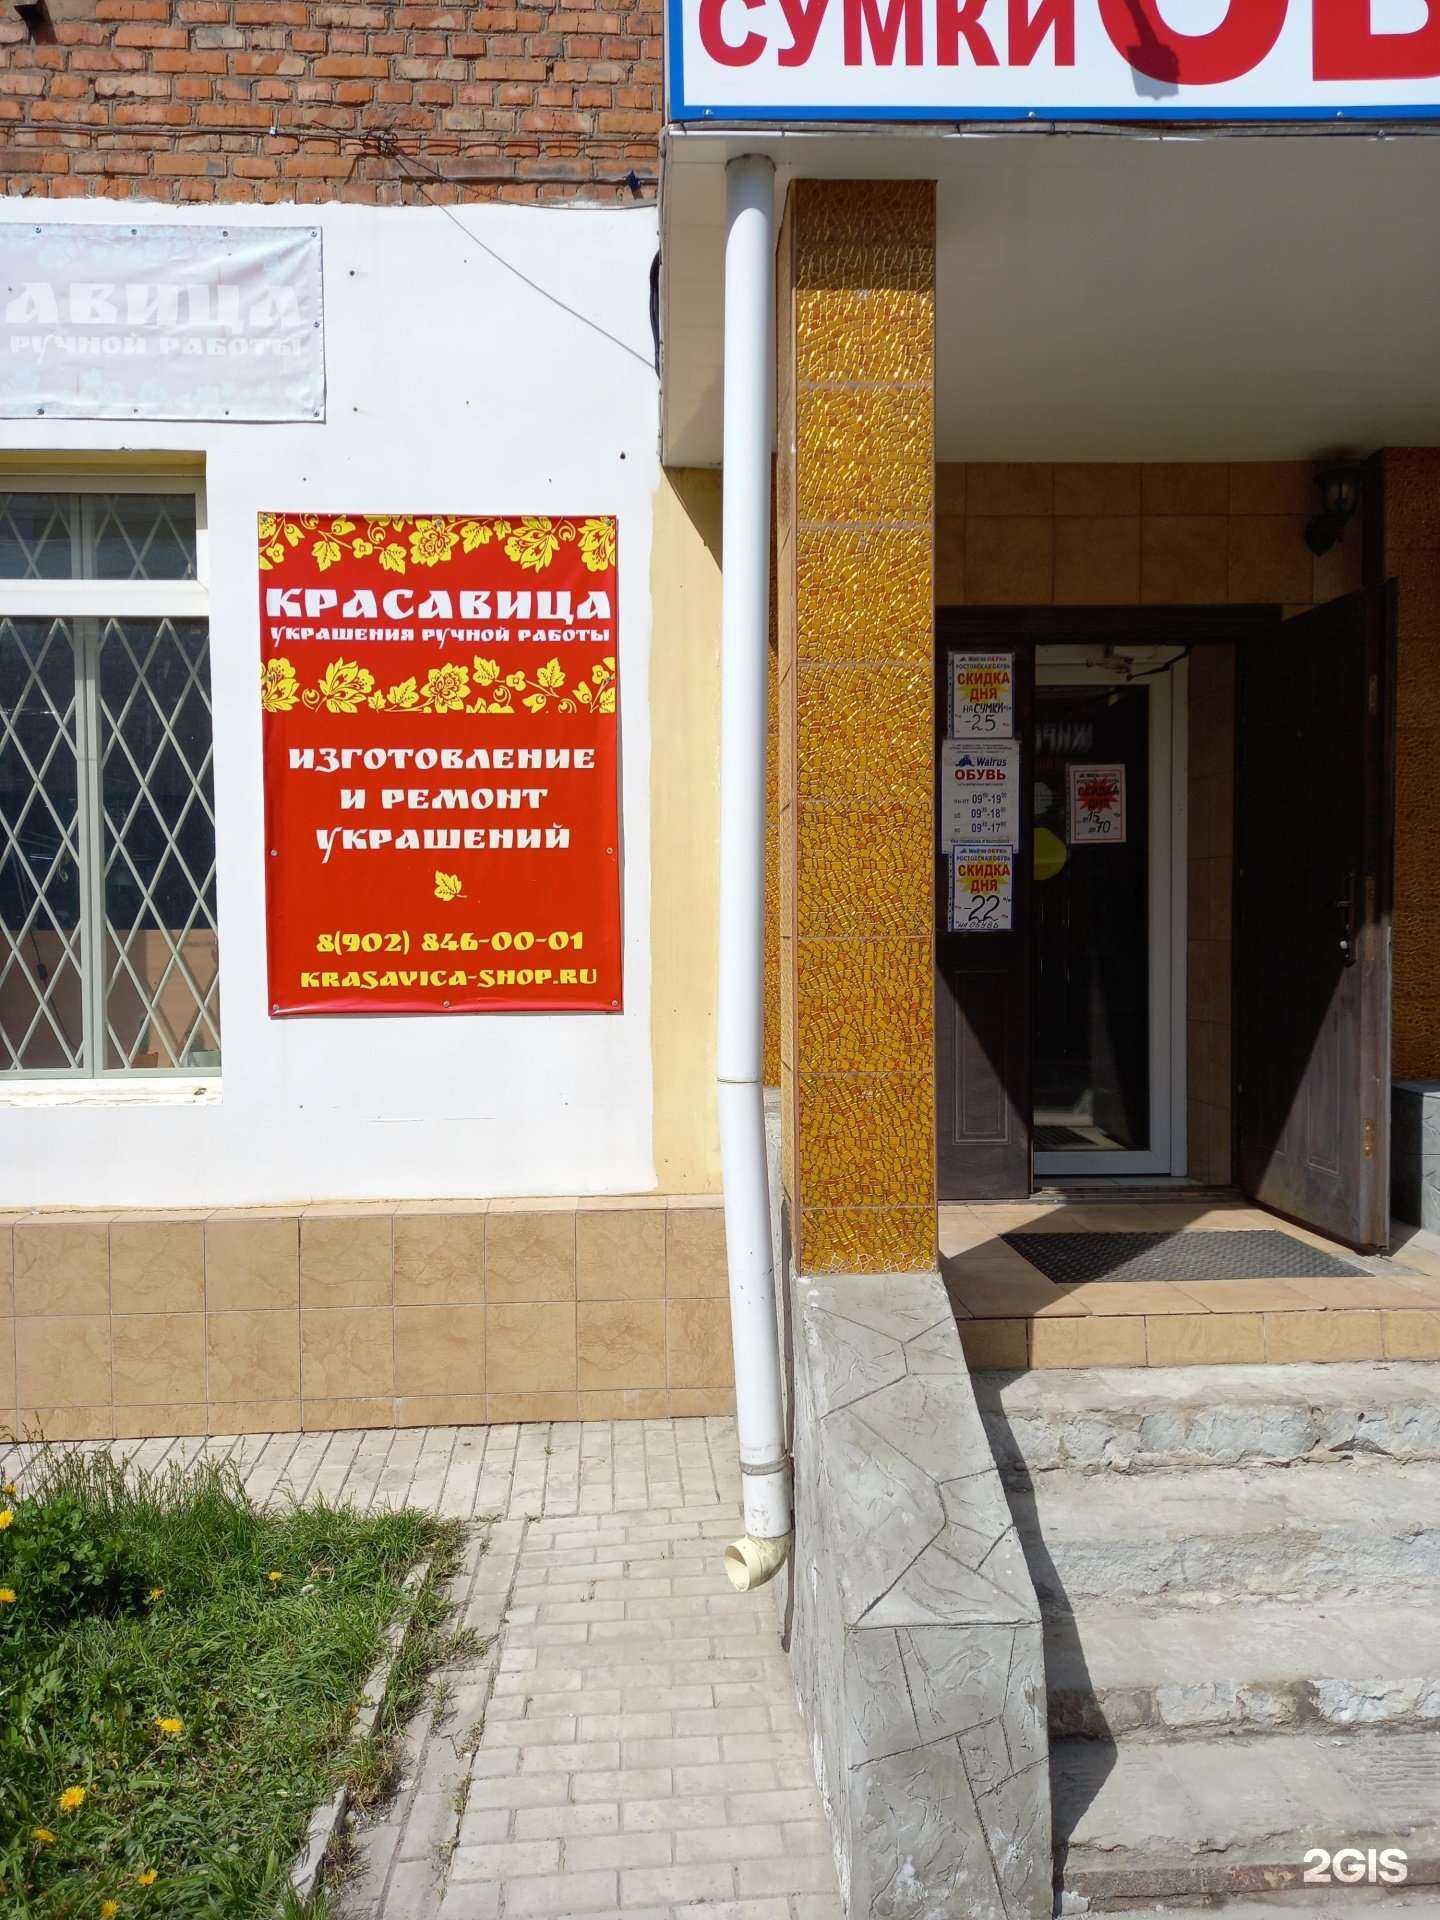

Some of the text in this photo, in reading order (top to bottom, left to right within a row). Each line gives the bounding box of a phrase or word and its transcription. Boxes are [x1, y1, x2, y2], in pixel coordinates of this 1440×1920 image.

[699, 0, 1076, 67] СУМКИ
[9, 333, 303, 366] РУЧНОЙ РАБОТЫ
[266, 587, 611, 625] КРАСАВИЦА
[270, 625, 610, 650] УКРАШЕНИЯ РУЧНОЙ РАБОТЫ
[957, 672, 1010, 687] СКИДКА
[969, 687, 997, 702] ДНЯ
[288, 747, 596, 773] ИЗГОТОВЛЕНИЕ
[976, 756, 1008, 767] Walrus
[954, 769, 1007, 781] ОБУВЬ
[340, 787, 549, 810] И РЕМОНТ
[315, 823, 570, 864] УКРАШЕНИЙ
[958, 864, 1011, 878] СКИДКА
[970, 879, 998, 893] ДНЯ
[316, 930, 584, 955] 8(902) 846-00-01
[300, 968, 598, 989] KRASAVICA-SHOP.RU
